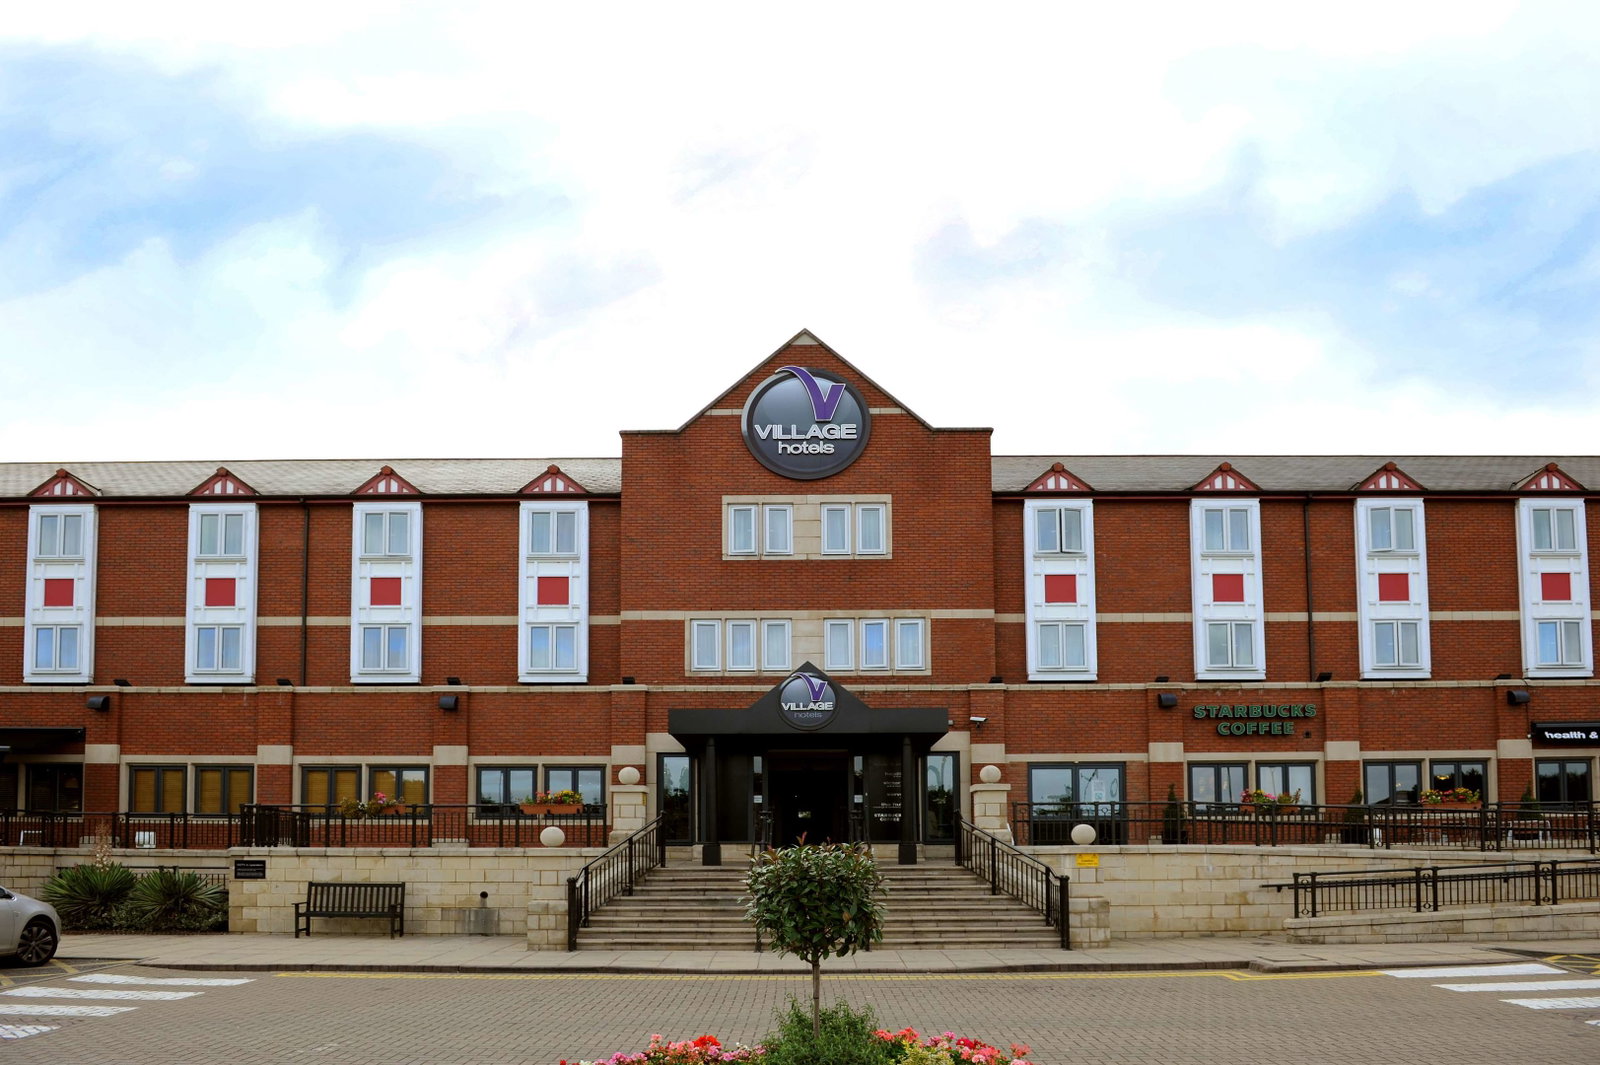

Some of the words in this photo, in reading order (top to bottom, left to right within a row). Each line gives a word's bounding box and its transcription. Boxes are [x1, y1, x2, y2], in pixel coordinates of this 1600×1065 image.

[754, 424, 857, 440] VILLAGE
[778, 441, 835, 455] hotels
[781, 702, 833, 710] VILLAGE
[1194, 704, 1317, 718] STARBUCKS
[1217, 722, 1295, 736] COFFEE
[1545, 731, 1586, 739] health
[1589, 731, 1599, 739] &
